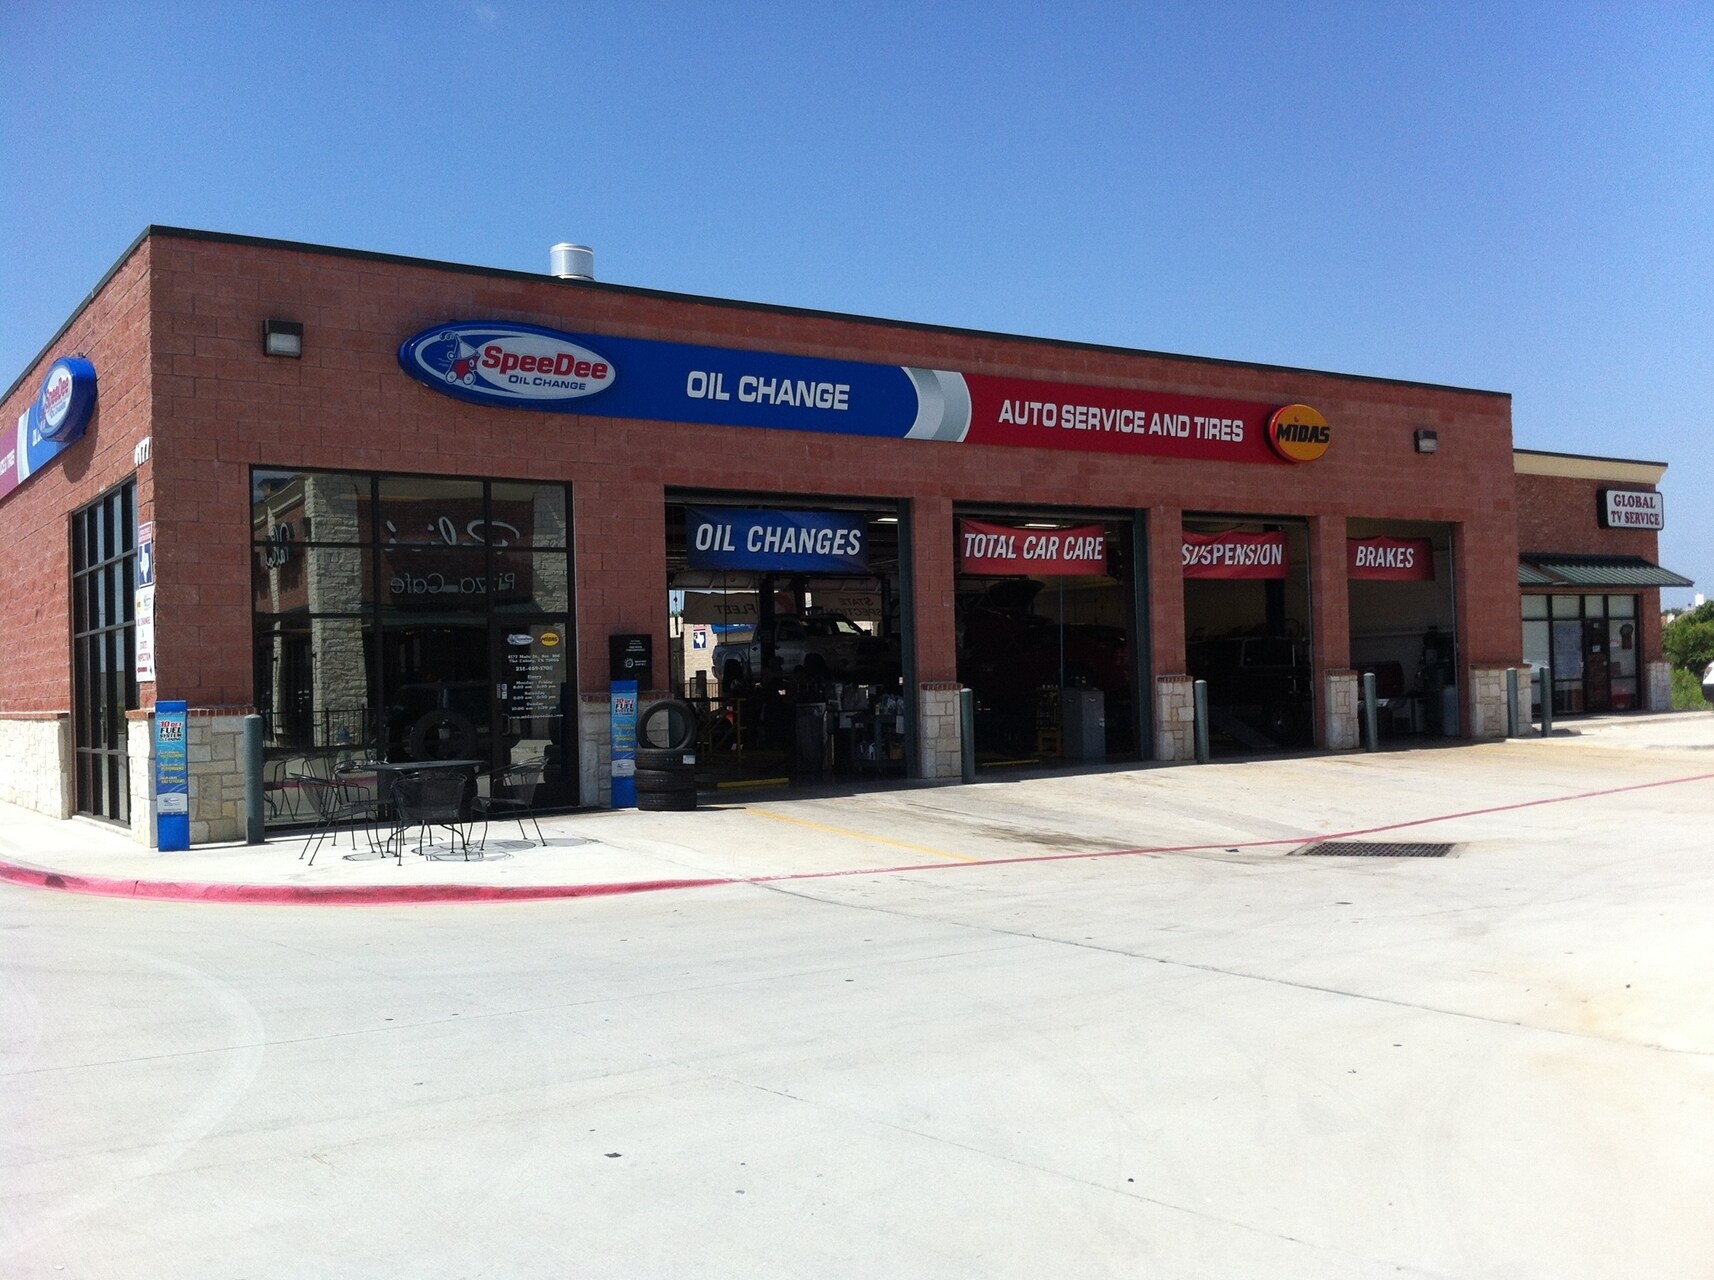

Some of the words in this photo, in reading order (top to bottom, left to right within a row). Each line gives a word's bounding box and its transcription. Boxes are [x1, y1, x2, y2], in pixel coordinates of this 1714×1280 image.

[482, 345, 608, 379] SpeeDee
[508, 375, 530, 386] OIL
[533, 377, 586, 391] CHANGE
[686, 370, 730, 401] OIL
[738, 375, 850, 411] CHANGE
[998, 399, 1058, 428] AUTO
[1061, 404, 1146, 434] SERVICE
[1148, 412, 1190, 438] AND
[1194, 416, 1244, 443] TIRES
[1277, 421, 1330, 444] MIDAS
[1613, 494, 1656, 509] GLOBAL
[1611, 510, 1623, 523] TV
[1624, 511, 1660, 526] SERVICE
[695, 523, 736, 552] OIL
[746, 525, 862, 556] CHANGES
[964, 533, 1017, 559] TOTAL
[1022, 535, 1060, 560] CAR
[1063, 536, 1104, 560] CARE
[1181, 542, 1283, 566] SUSPENSION
[1355, 546, 1414, 569] BRAKES
